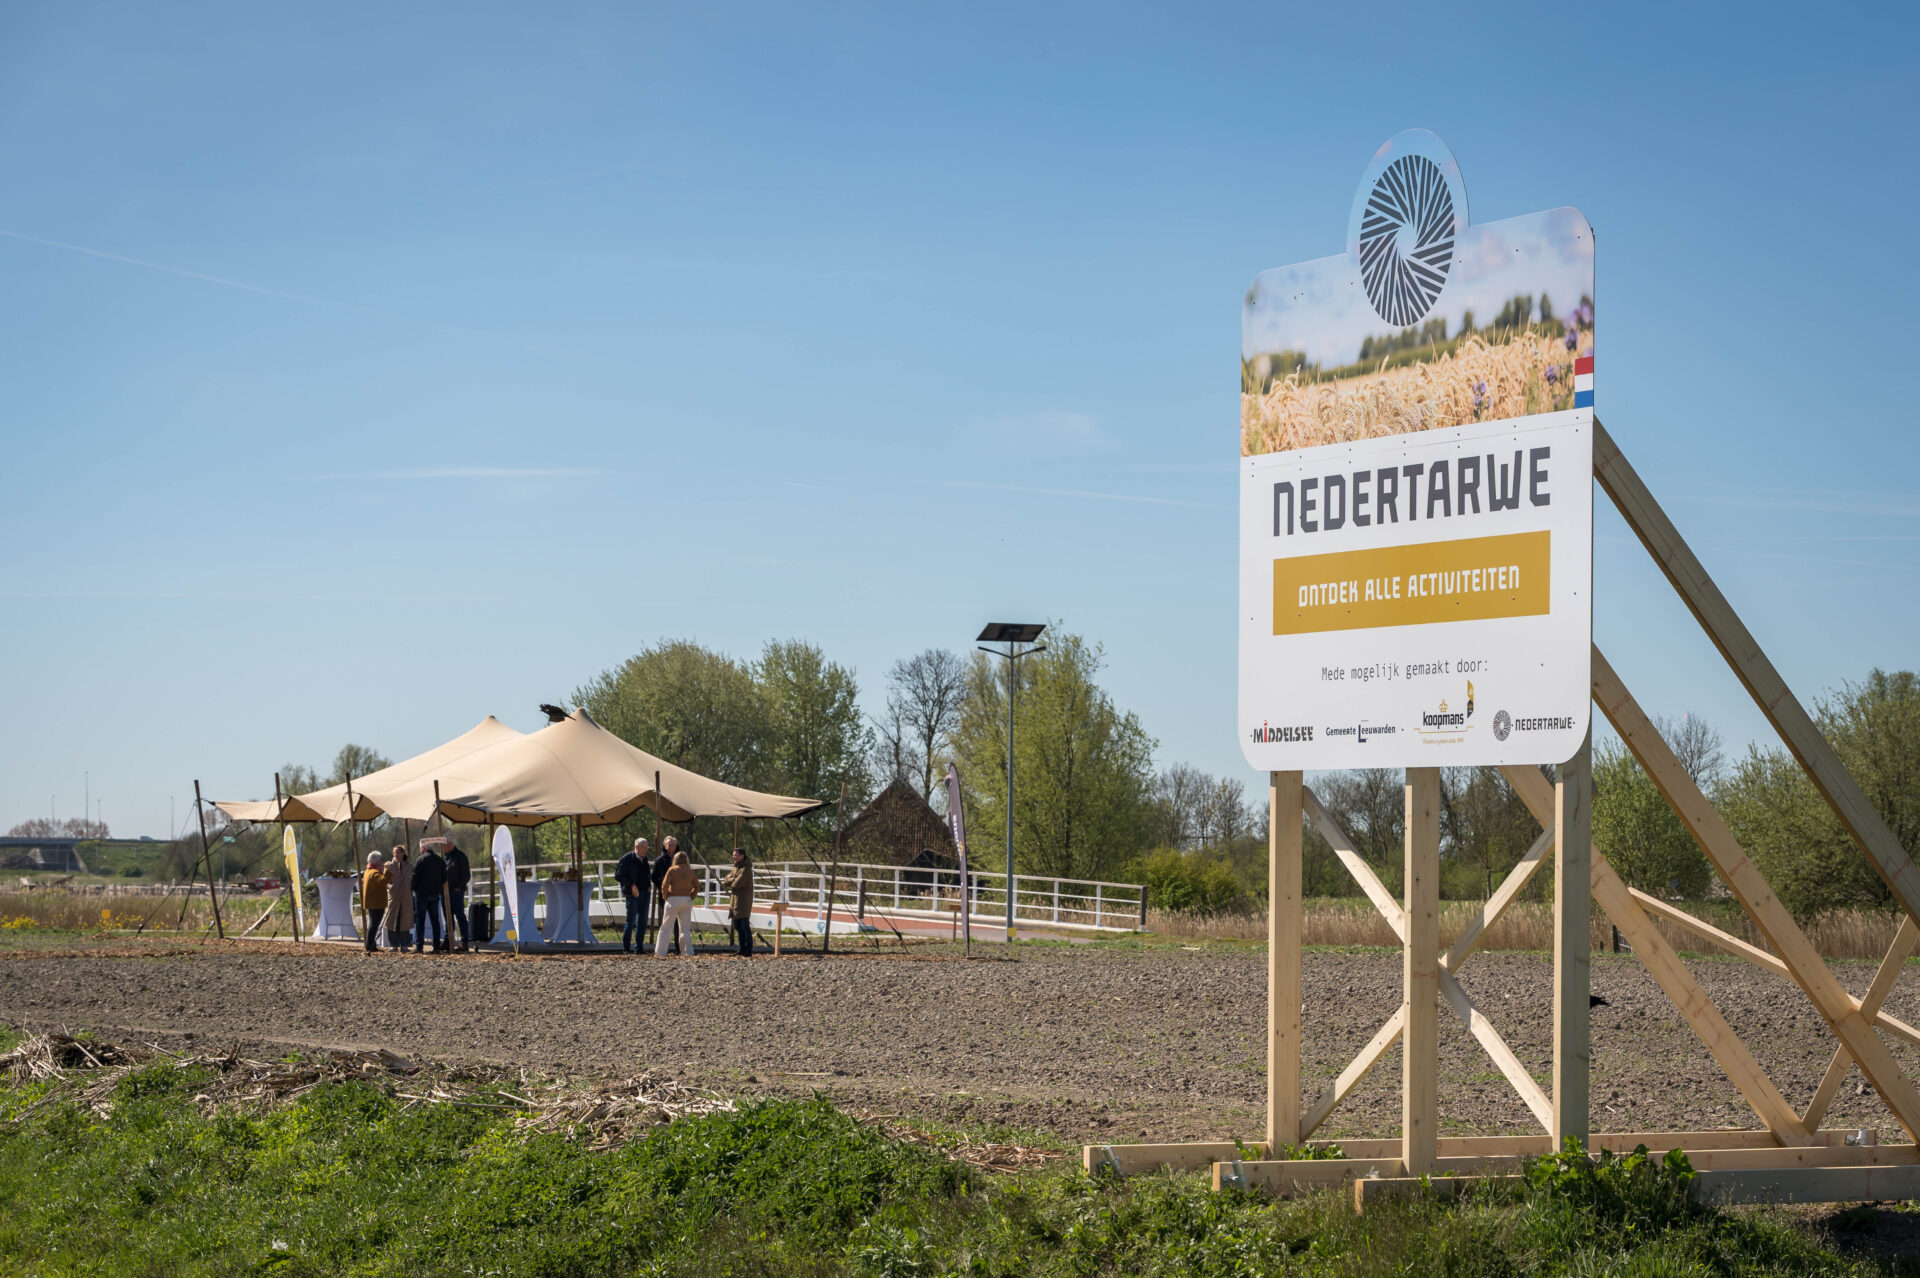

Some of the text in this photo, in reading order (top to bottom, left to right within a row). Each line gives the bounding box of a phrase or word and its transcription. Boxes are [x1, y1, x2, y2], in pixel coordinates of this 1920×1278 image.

[1273, 446, 1551, 537] NEDERTARWE
[1298, 565, 1520, 608] ONTDEK ALLE ACTIVITEITEN
[1321, 658, 1488, 682] Mede mogelijk gemaakt door:
[1422, 710, 1465, 730] koopmans
[1515, 717, 1573, 731] NEDERTARWE
[1325, 723, 1396, 743] Gemeente Leeuwarden
